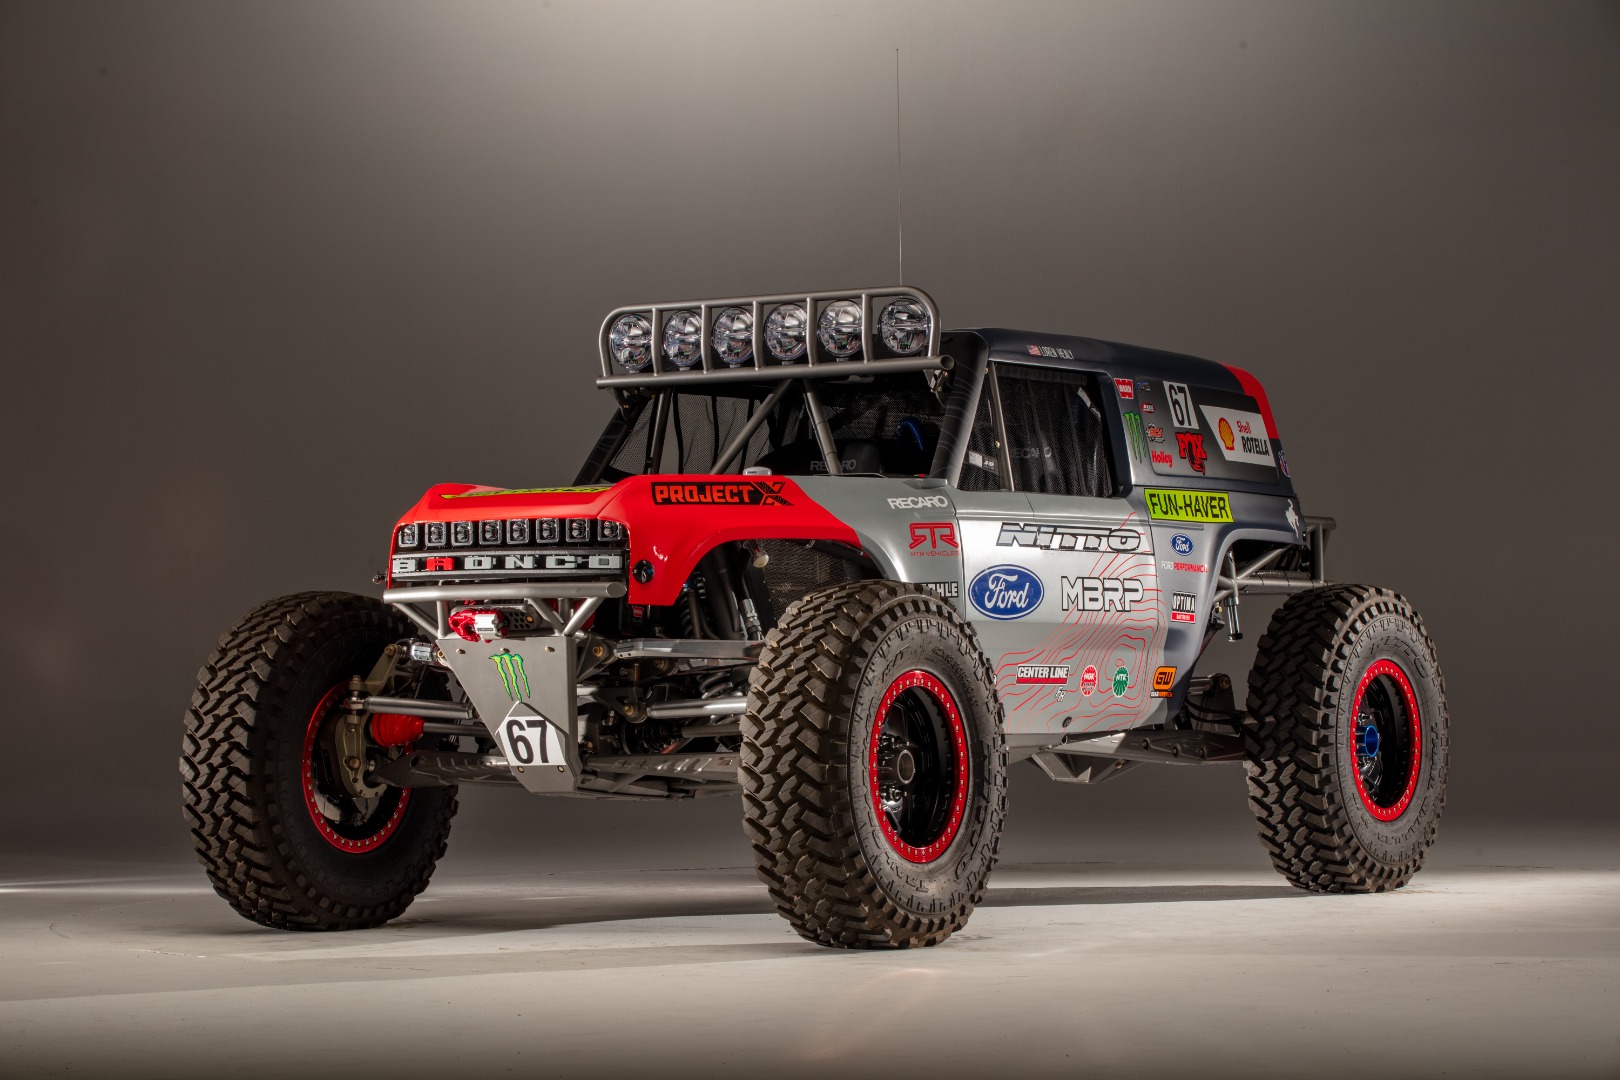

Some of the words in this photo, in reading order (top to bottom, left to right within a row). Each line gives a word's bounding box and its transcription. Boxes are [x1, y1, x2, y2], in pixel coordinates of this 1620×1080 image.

[1168, 383, 1192, 427] 67
[1236, 420, 1252, 434] Shell
[1175, 432, 1207, 470] FOX
[1241, 436, 1271, 457] ROTELLA
[1151, 451, 1173, 469] Holley
[654, 485, 755, 503] PROJECT
[887, 495, 949, 510] RECARO
[1149, 493, 1229, 519] FUN-HAVER
[995, 522, 1142, 552] NITTO
[1174, 536, 1190, 552] Ford
[392, 554, 623, 572] BRONCO
[1161, 561, 1174, 570] FORD
[984, 572, 1029, 610] Ford
[1060, 576, 1144, 612] MBRP
[1172, 595, 1195, 612] OPTIMA
[1017, 666, 1049, 678] CENTER
[1050, 667, 1069, 679] LINE
[1083, 673, 1095, 681] NGK
[1115, 673, 1128, 681] NTK
[505, 719, 550, 765] 67
